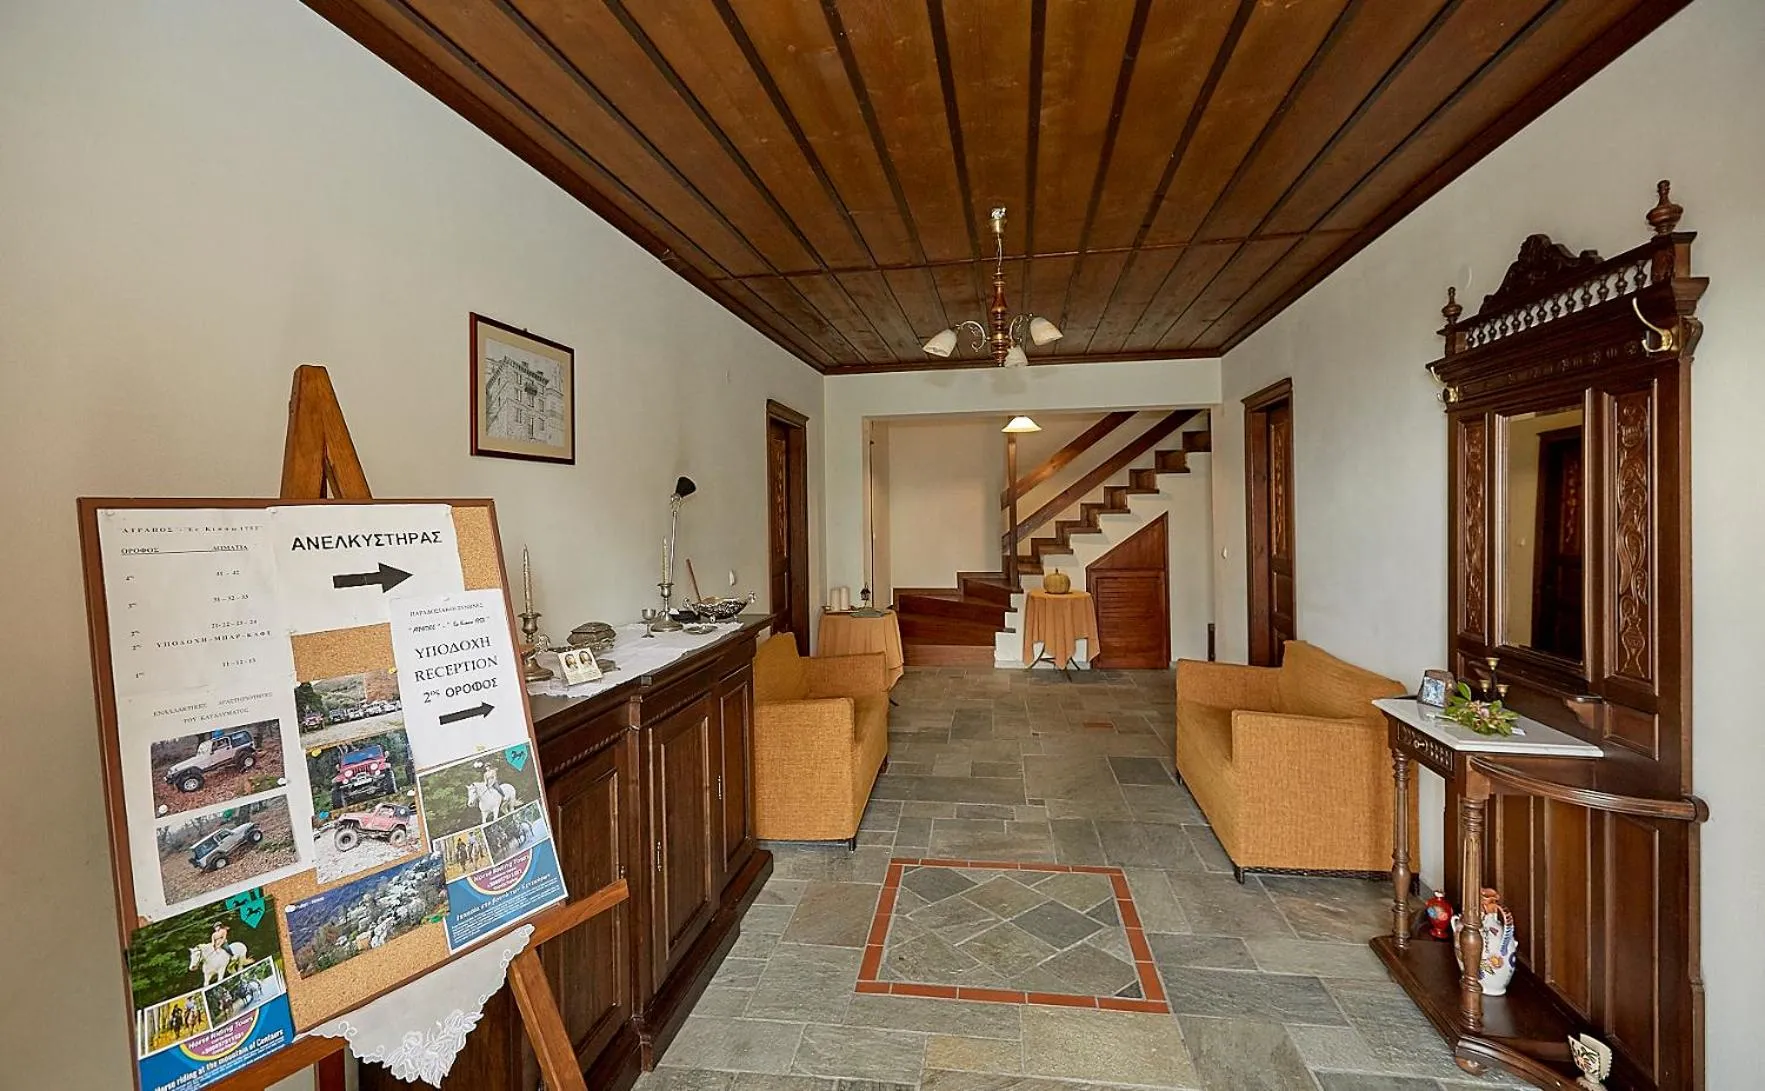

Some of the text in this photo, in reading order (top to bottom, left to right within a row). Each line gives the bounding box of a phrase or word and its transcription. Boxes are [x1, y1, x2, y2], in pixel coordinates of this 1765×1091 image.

[291, 530, 443, 551] ΑΝΕΛΚΥΣΤΗΡΑΣ
[415, 636, 492, 660] ΥΠΟΔΟΧΗ
[414, 655, 498, 682] RECEPTION
[445, 677, 498, 698] ΟΡΟΦΟΣ
